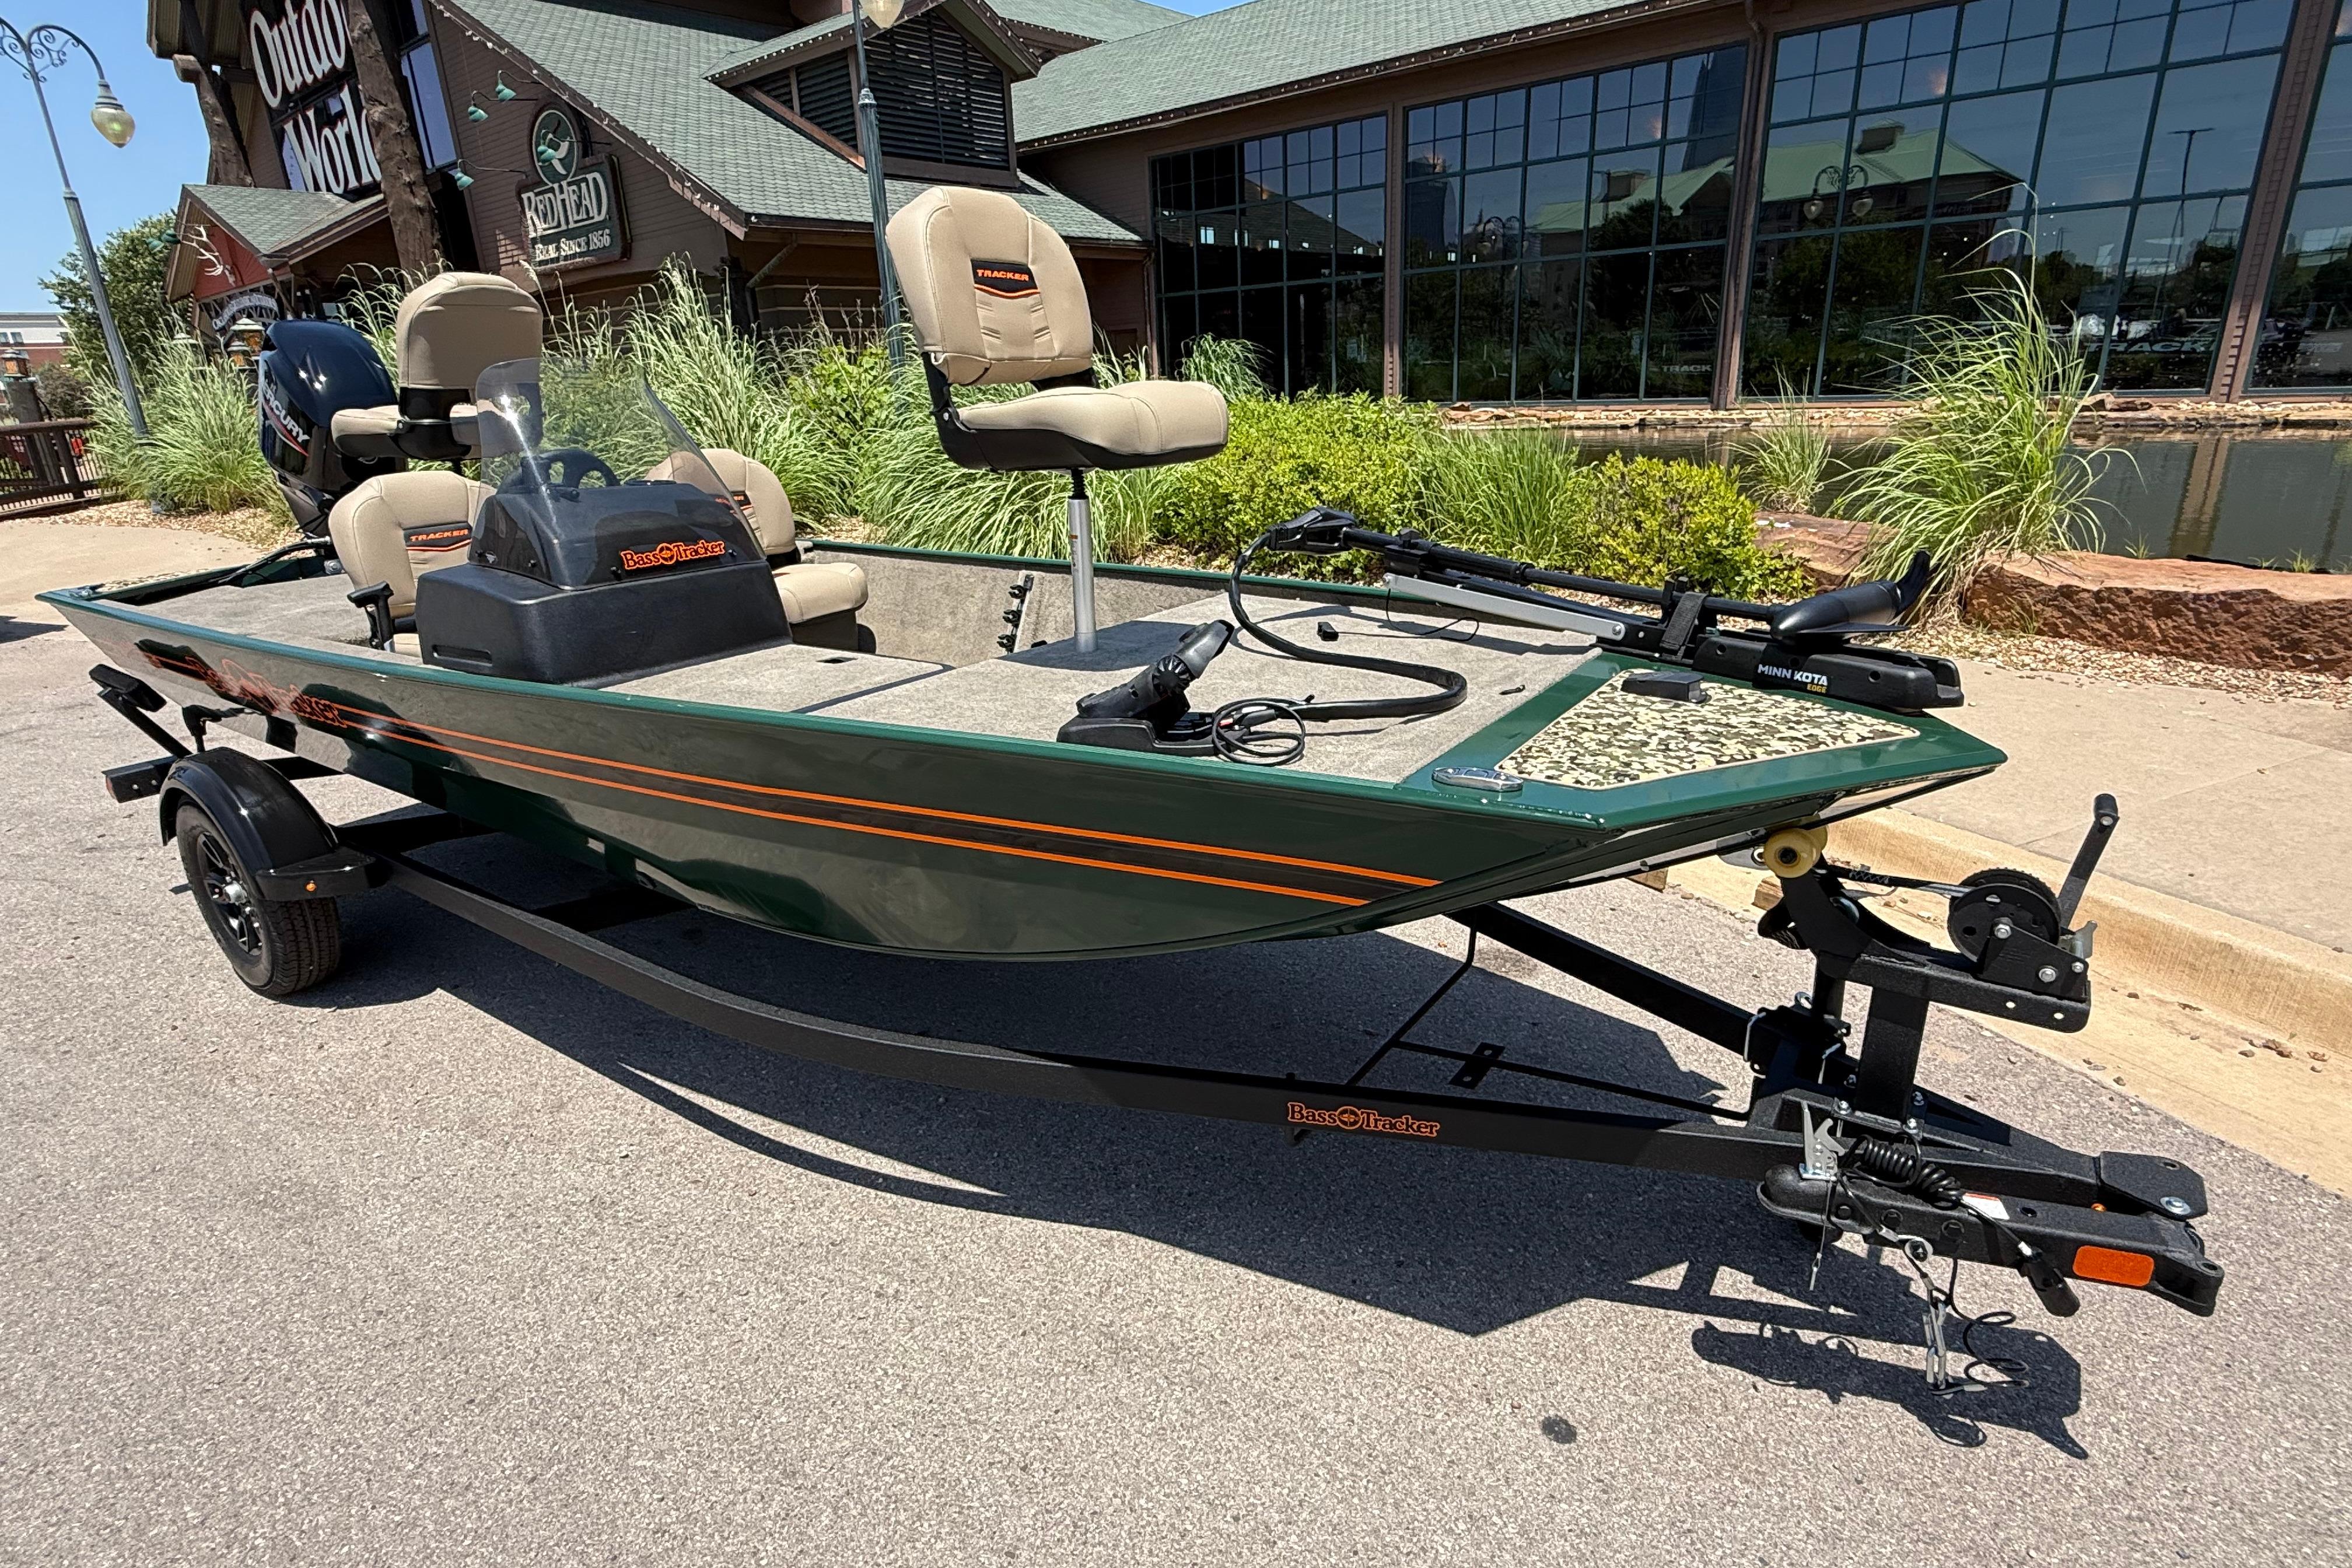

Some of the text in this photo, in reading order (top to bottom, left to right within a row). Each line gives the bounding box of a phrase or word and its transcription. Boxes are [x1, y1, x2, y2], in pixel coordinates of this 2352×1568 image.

[250, 0, 352, 108] Outdo
[588, 229, 611, 250] 1856
[977, 270, 1029, 281] TRACKER
[2084, 341, 2218, 352] TRACK
[410, 528, 469, 542] TRACKER
[621, 540, 726, 569] Bass Tracker
[1757, 664, 1828, 686] MINN KOTA
[1807, 684, 1828, 694] EDGE
[1287, 1102, 1441, 1137] Bass Tracker
